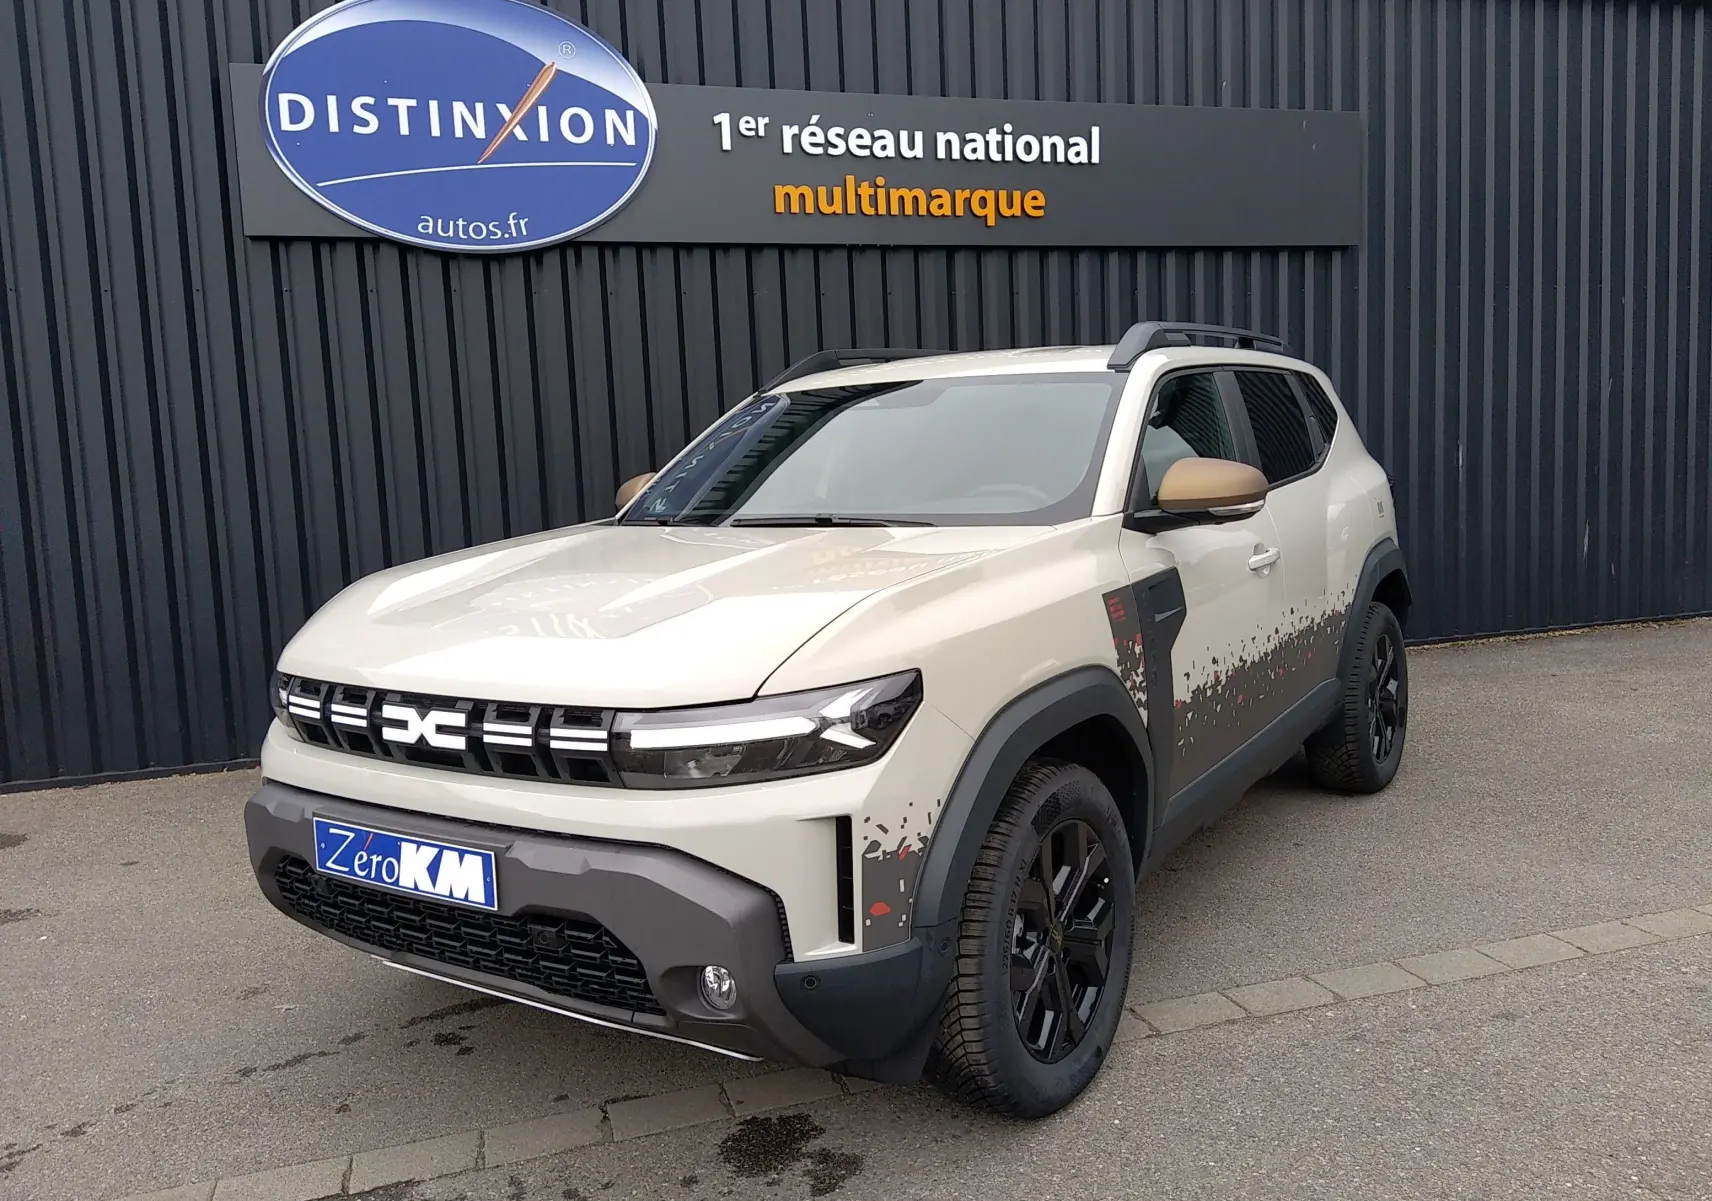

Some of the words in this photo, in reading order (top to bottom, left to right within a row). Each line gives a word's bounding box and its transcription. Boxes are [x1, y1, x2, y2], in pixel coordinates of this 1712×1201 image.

[278, 91, 636, 147] DISTINXION
[712, 112, 770, 151] 1er
[781, 114, 924, 160] réseau
[935, 123, 1101, 164] national
[416, 211, 529, 241] autos.fr
[774, 174, 1047, 227] multimarque
